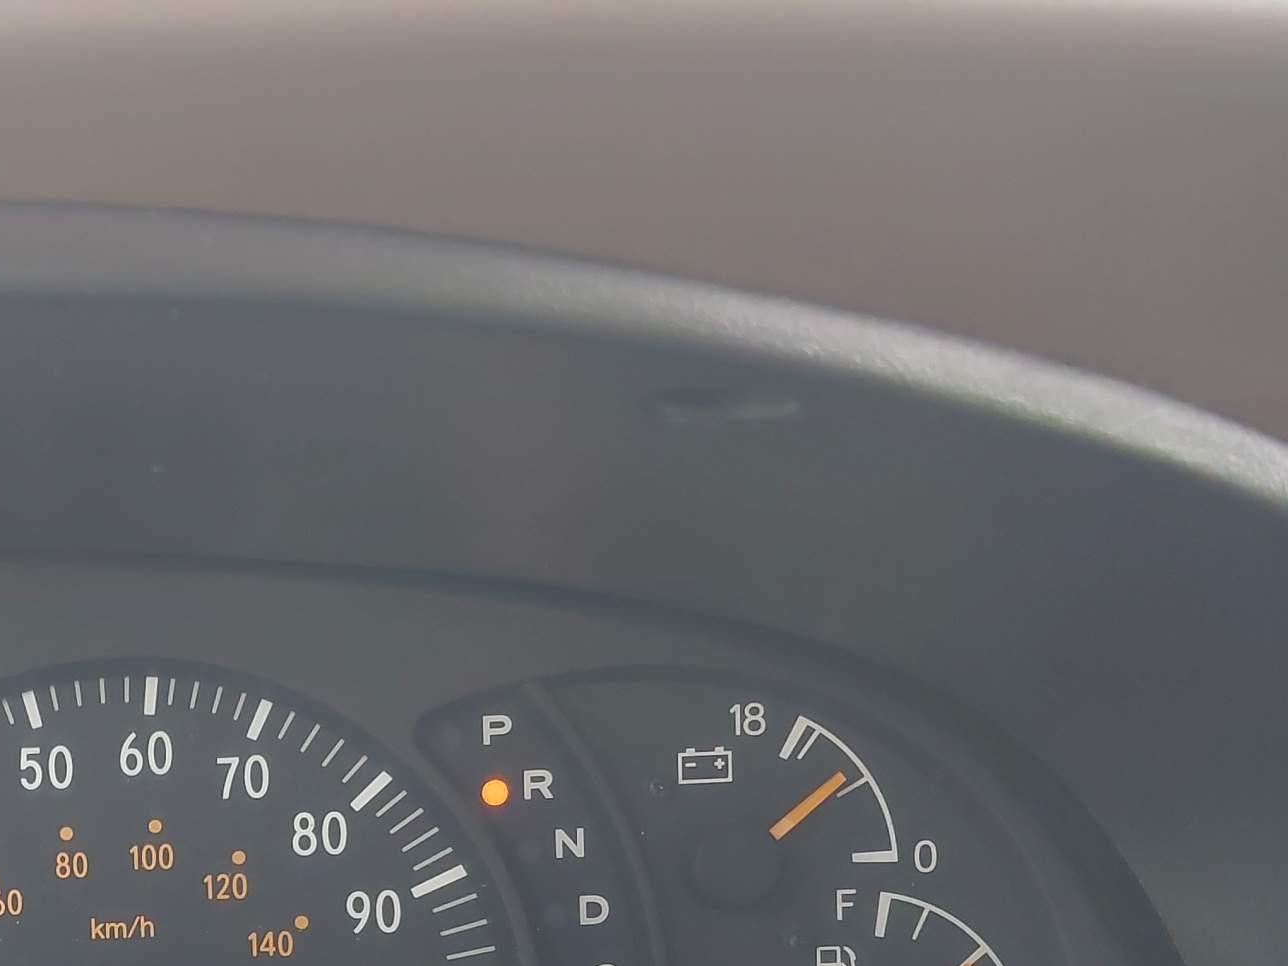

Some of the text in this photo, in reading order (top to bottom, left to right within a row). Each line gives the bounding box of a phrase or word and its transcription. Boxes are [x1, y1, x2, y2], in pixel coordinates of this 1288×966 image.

[482, 714, 512, 746] P
[729, 702, 766, 736] 18
[20, 745, 73, 791] 50
[119, 730, 173, 777] 60
[216, 754, 269, 800] 70
[523, 769, 554, 800] R
[292, 811, 348, 857] 80
[555, 827, 585, 859] N
[55, 851, 89, 880] 80
[129, 843, 174, 871] 100
[913, 839, 938, 873] 0
[203, 873, 249, 900] 120
[346, 889, 401, 934] 90
[579, 894, 610, 926] D
[836, 888, 858, 921] F
[90, 915, 156, 941] km/h
[247, 931, 294, 957] 140
